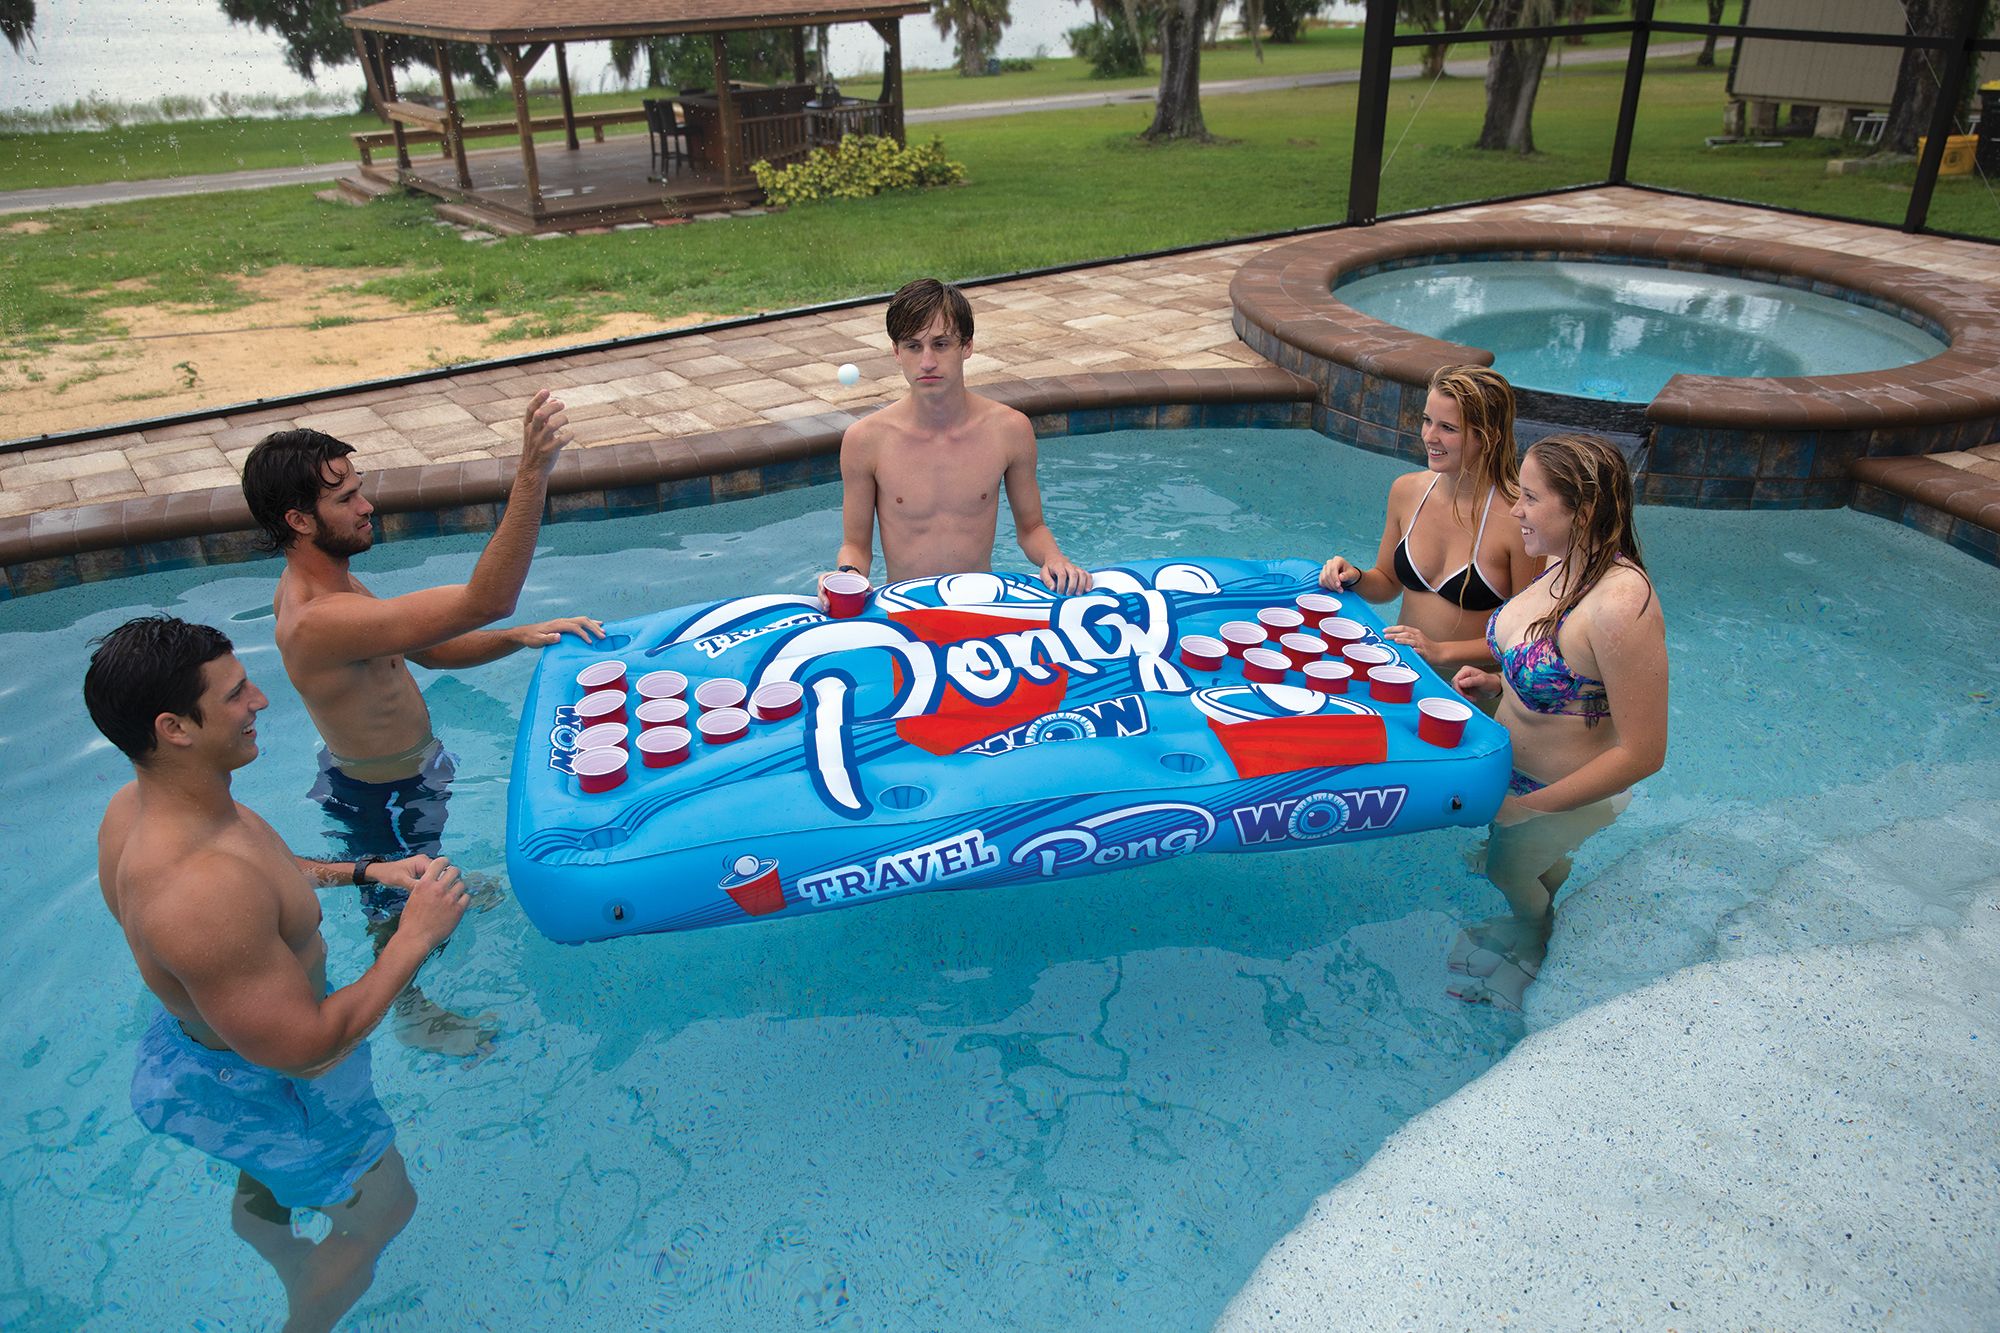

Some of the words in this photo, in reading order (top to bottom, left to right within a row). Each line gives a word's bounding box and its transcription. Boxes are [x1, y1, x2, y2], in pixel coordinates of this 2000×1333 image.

[800, 833, 997, 905] TRAVEL
[1011, 802, 1216, 877] Pong
[1231, 786, 1408, 846] WOW
